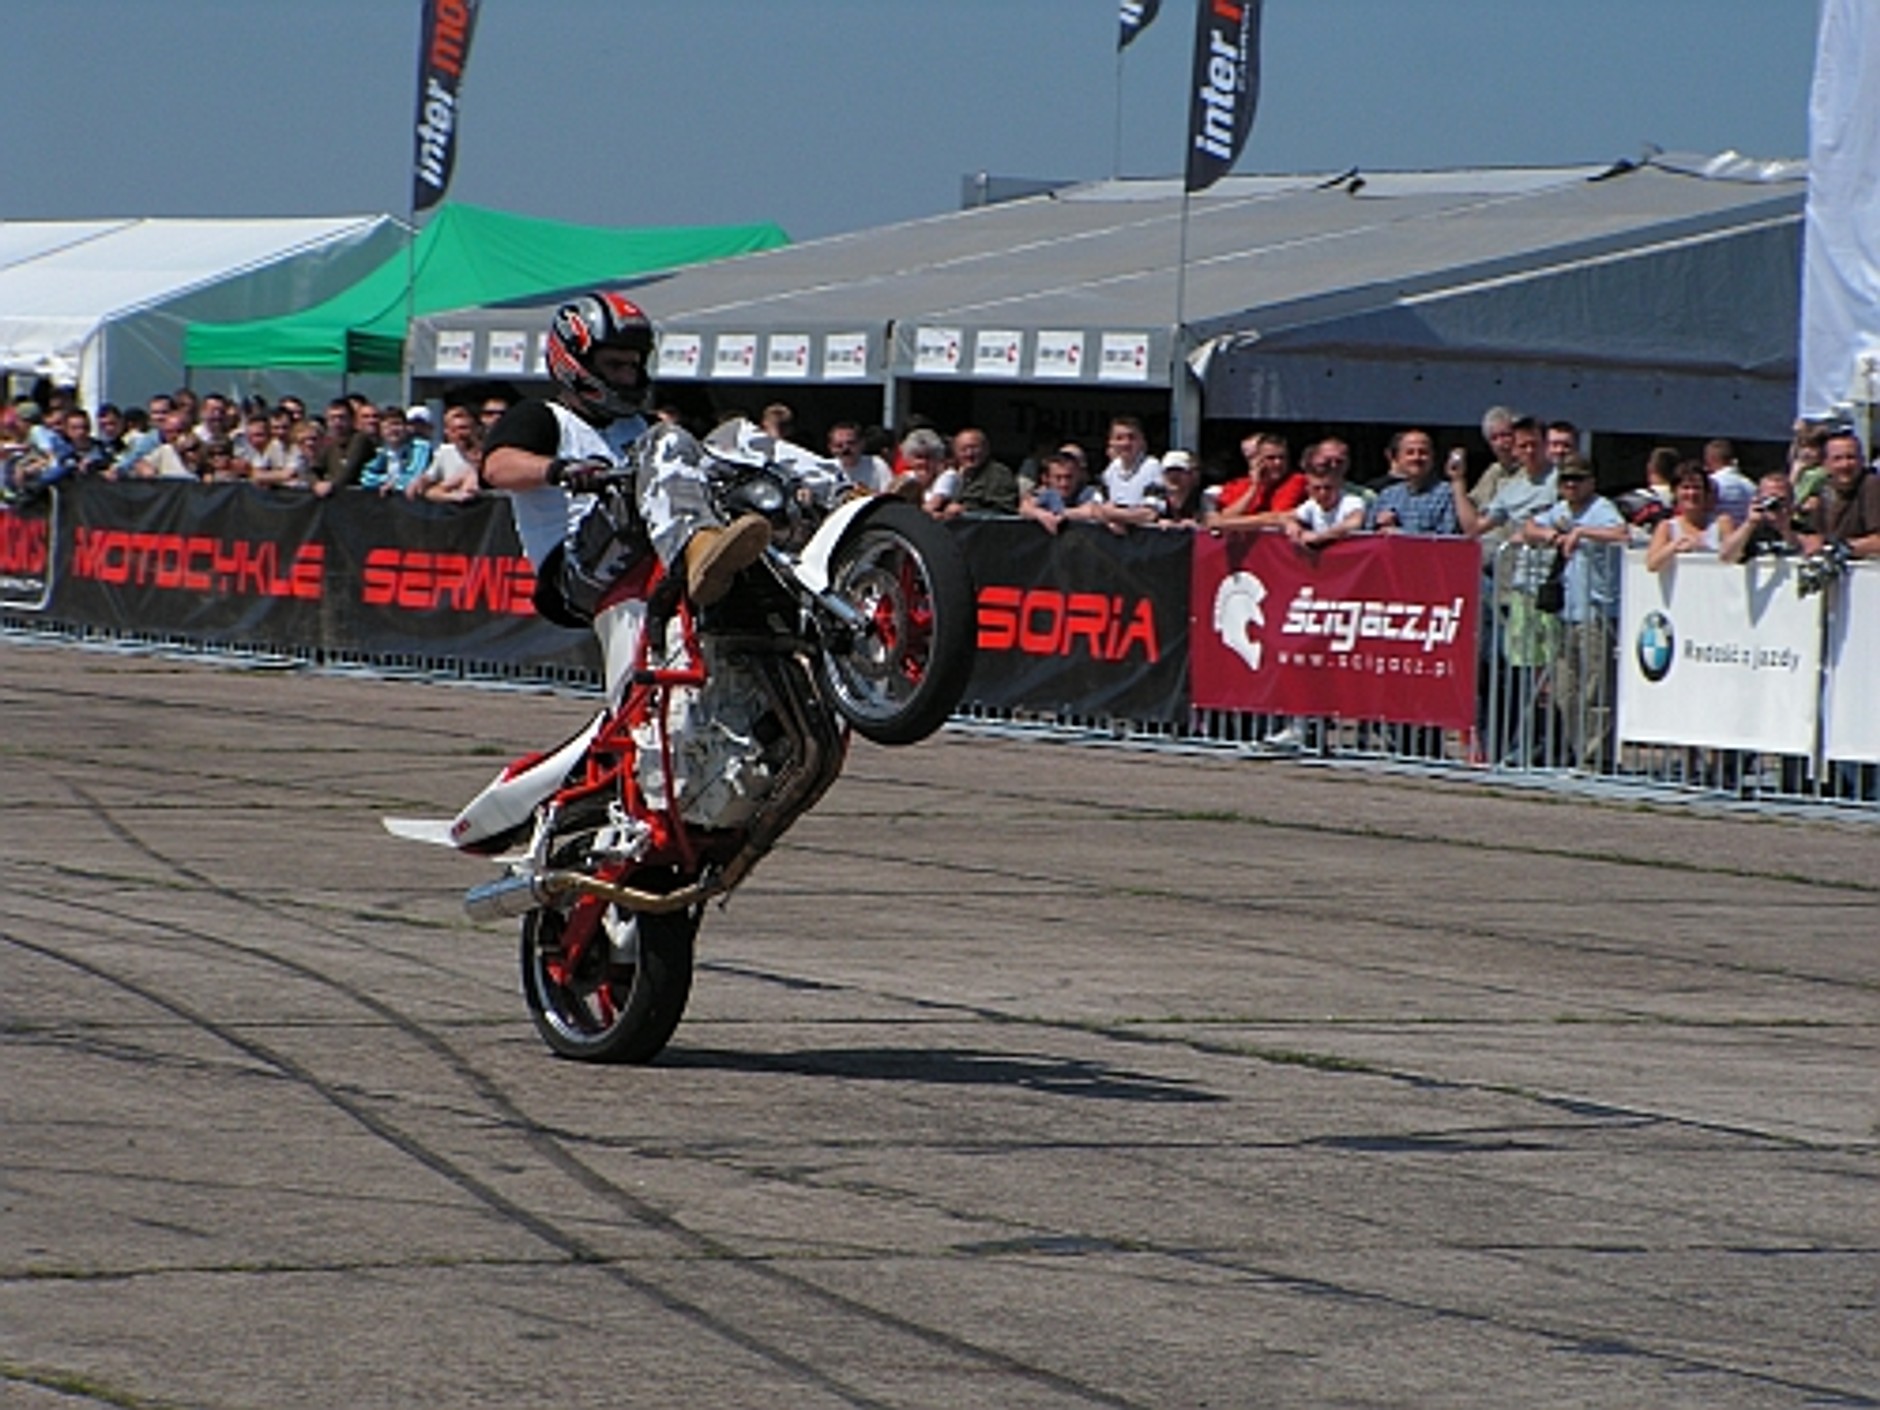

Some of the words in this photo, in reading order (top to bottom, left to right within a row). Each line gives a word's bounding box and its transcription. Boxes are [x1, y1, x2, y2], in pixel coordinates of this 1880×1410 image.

[417, 77, 454, 189] inter
[1195, 29, 1239, 160] inter
[73, 526, 325, 599] MOTOCYKLE
